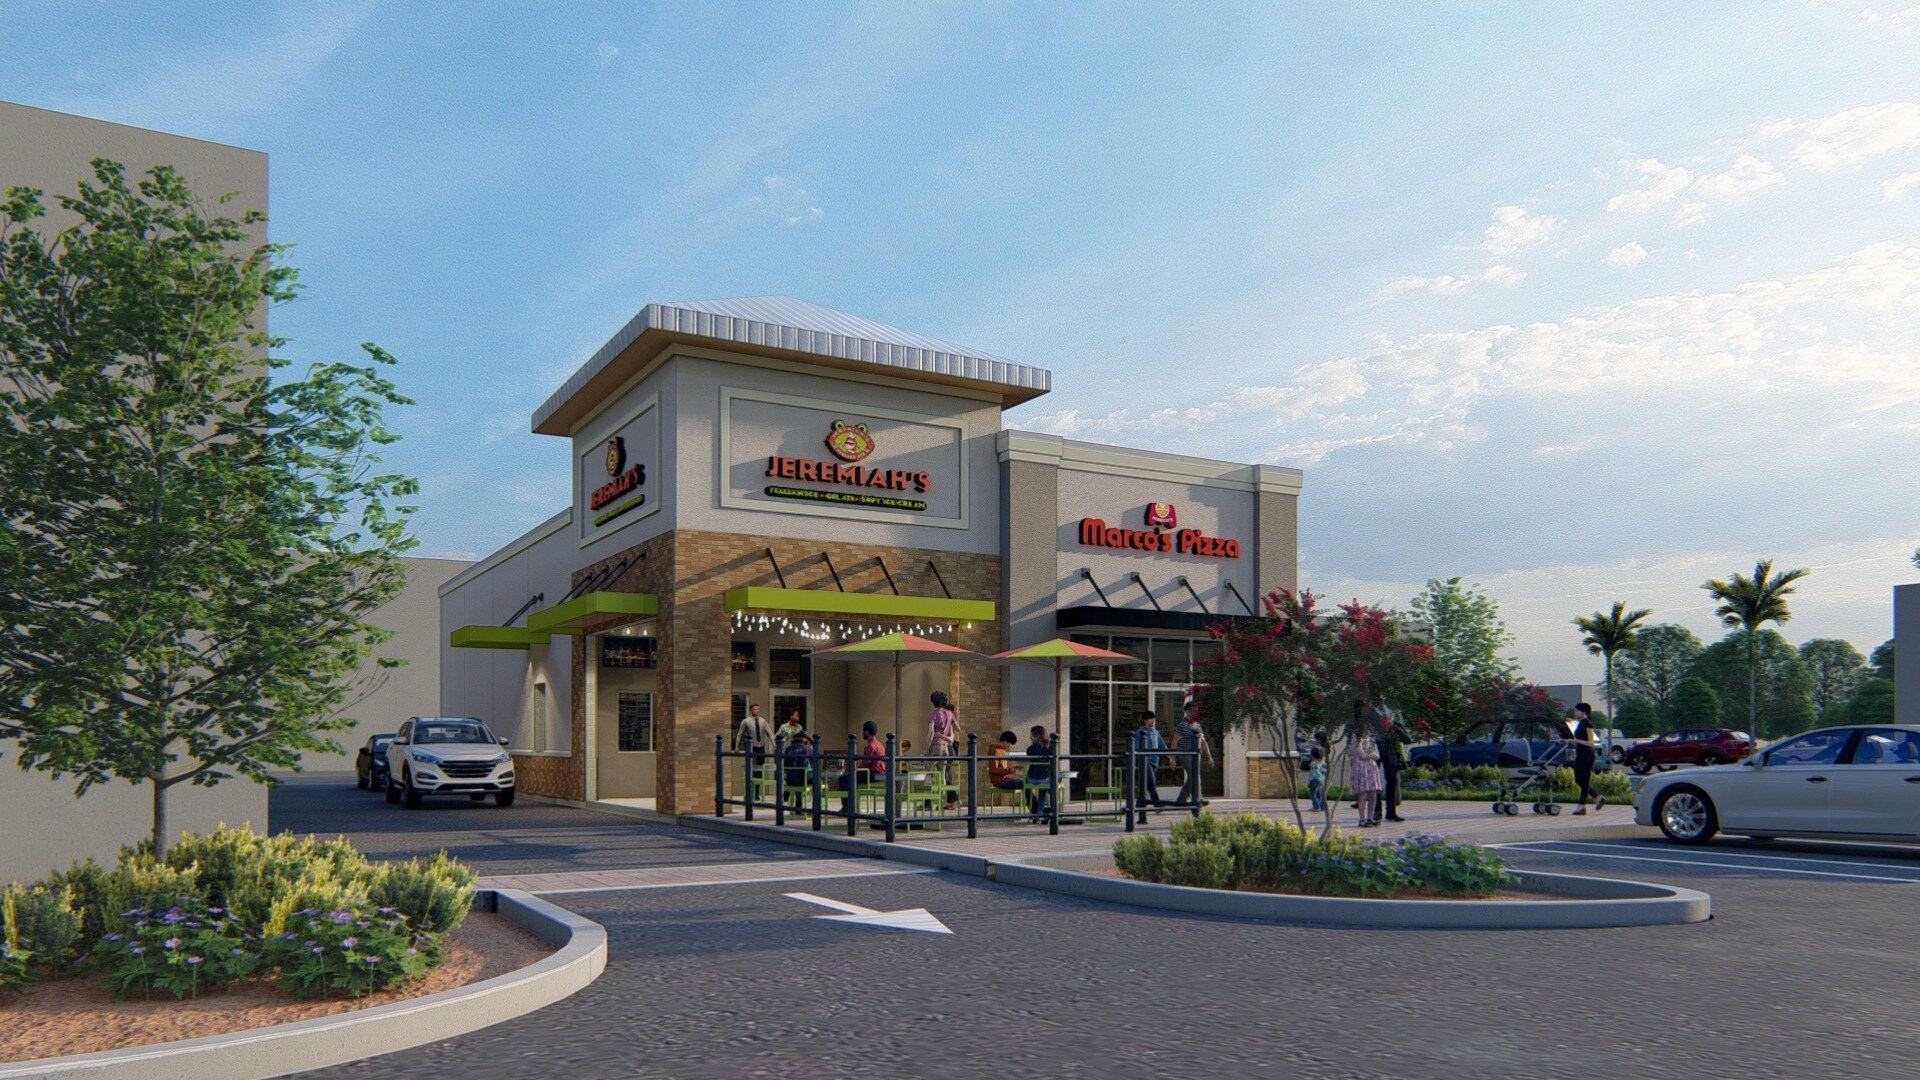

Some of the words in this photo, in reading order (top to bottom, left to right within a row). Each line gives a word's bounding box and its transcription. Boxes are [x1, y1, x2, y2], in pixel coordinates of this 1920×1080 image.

[766, 456, 931, 492] JEREMIAH'S
[1079, 518, 1172, 552] Marco's
[1177, 528, 1240, 558] Pizza
